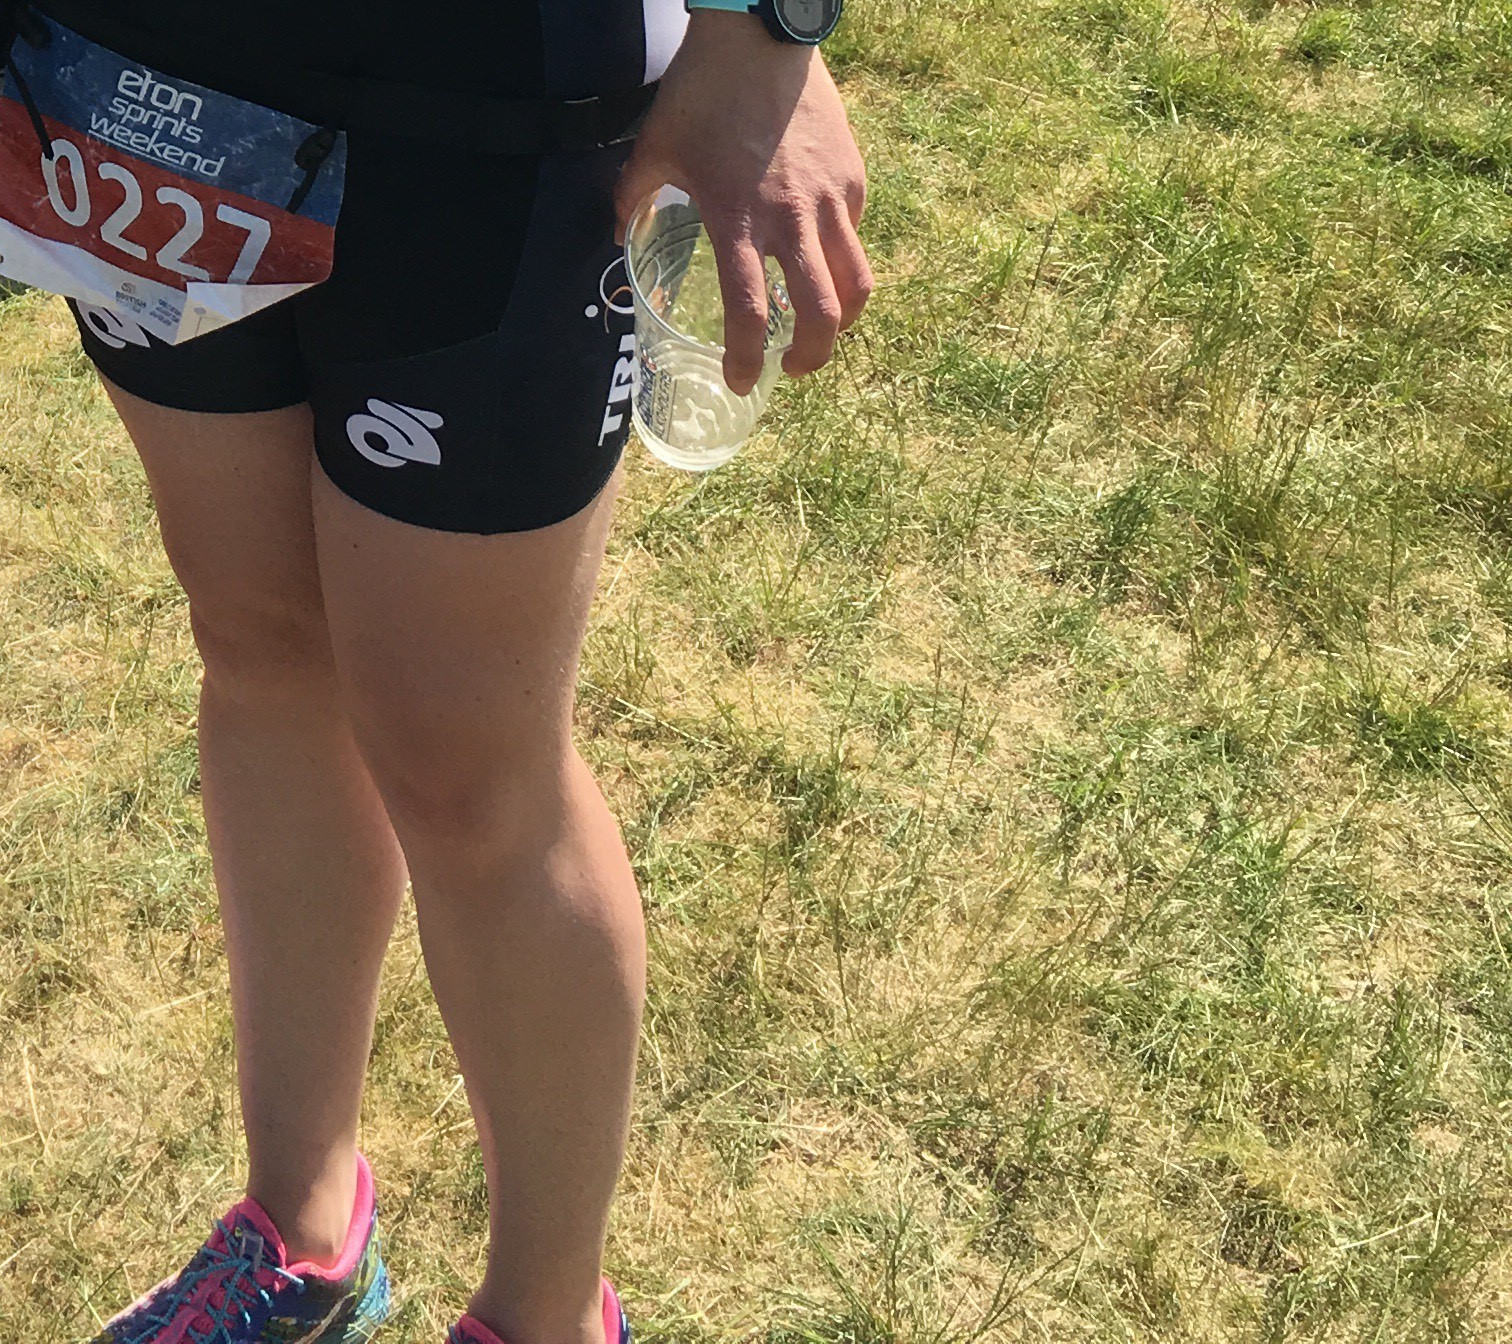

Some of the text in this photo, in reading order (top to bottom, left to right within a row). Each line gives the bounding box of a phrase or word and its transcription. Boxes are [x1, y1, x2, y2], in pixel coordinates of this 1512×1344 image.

[108, 97, 204, 144] sprints
[117, 68, 203, 121] eton
[90, 112, 226, 177] weekend
[40, 138, 272, 285] 0227
